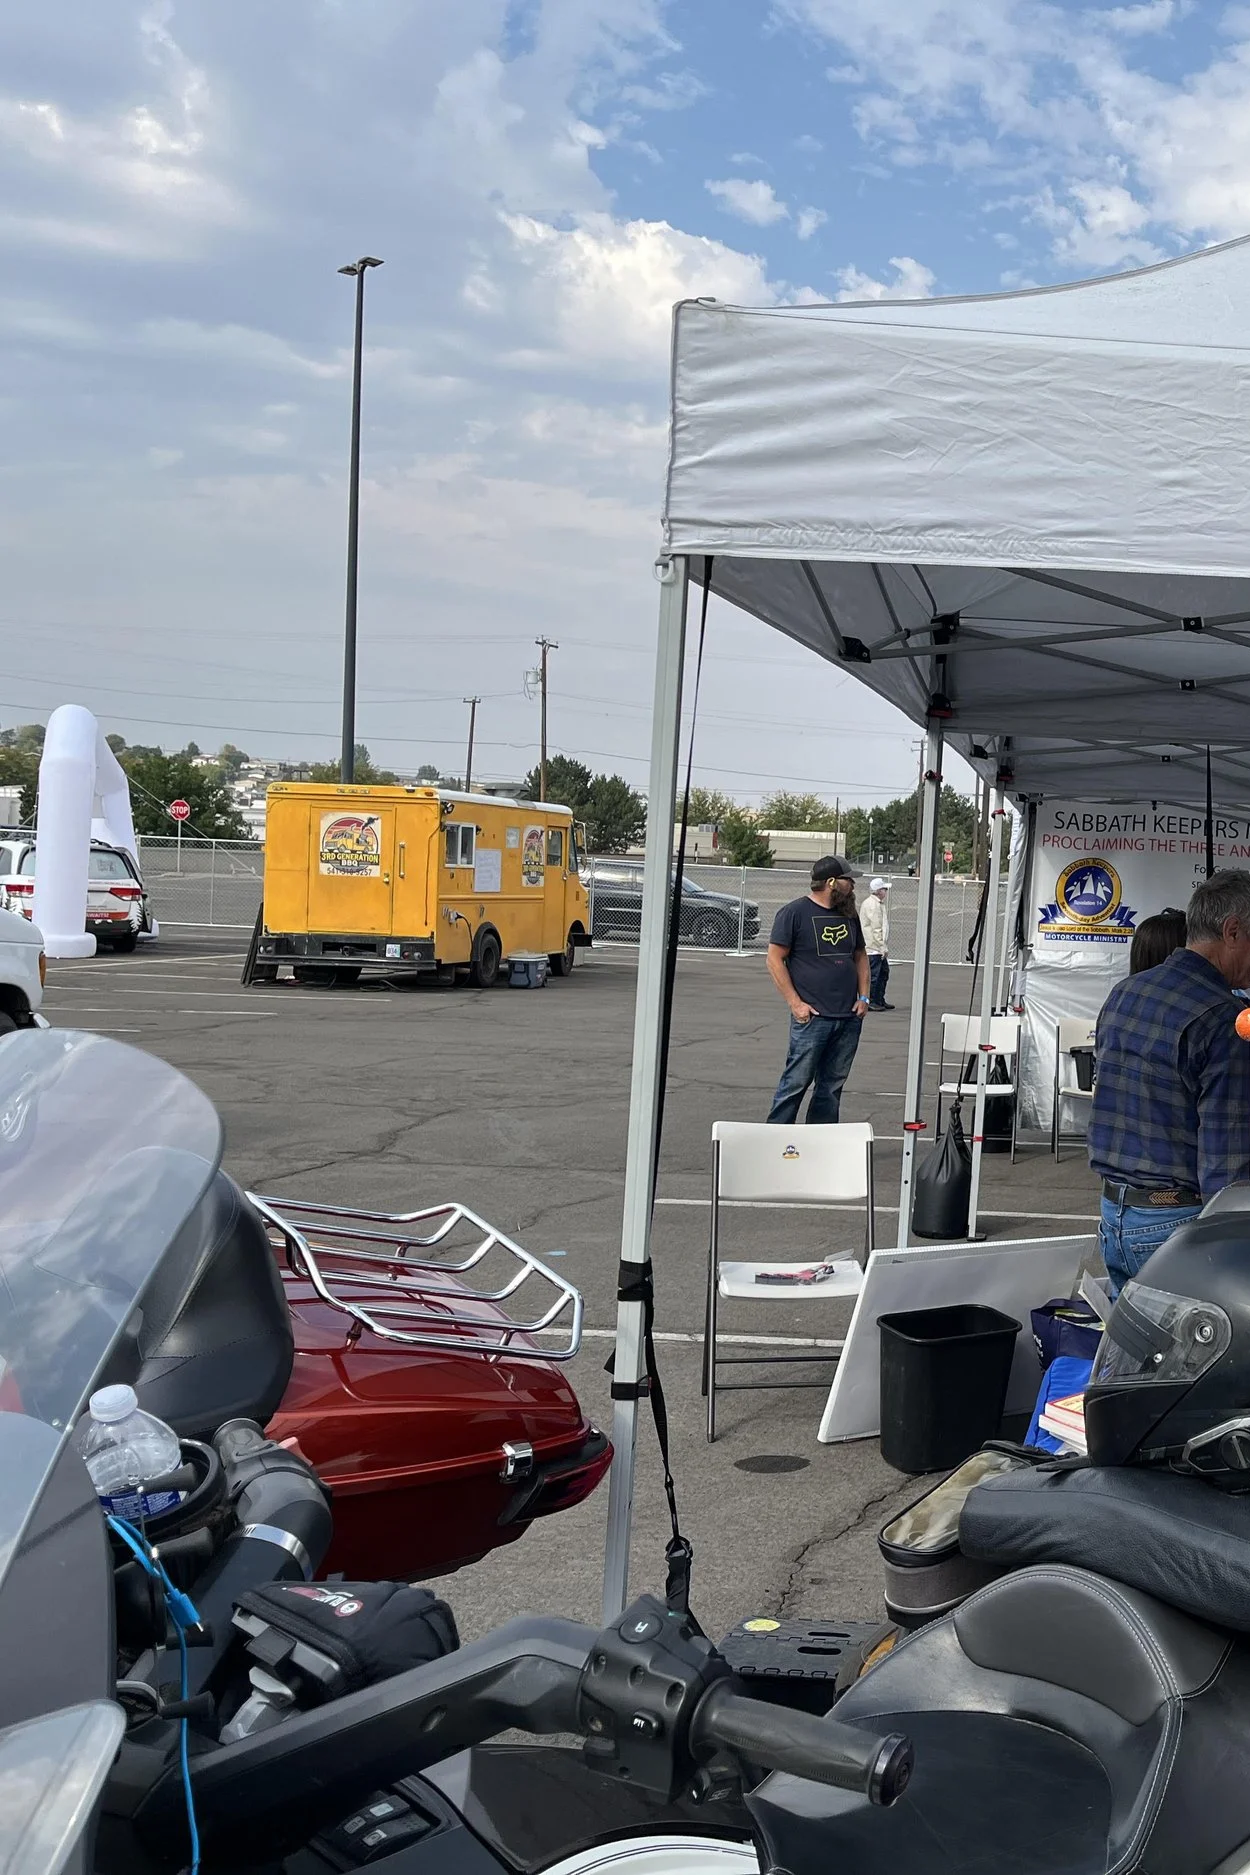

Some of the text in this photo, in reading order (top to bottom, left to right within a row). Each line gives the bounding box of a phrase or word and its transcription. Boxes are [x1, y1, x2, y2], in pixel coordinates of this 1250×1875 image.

[171, 806, 188, 814] STOP
[1054, 811, 1146, 832] SABBATH
[1042, 834, 1145, 851] PROCLAIMING
[1149, 838, 1176, 853] THE
[321, 853, 379, 863] 3RD GENERATION
[1045, 933, 1092, 941] MOTORCYCLE
